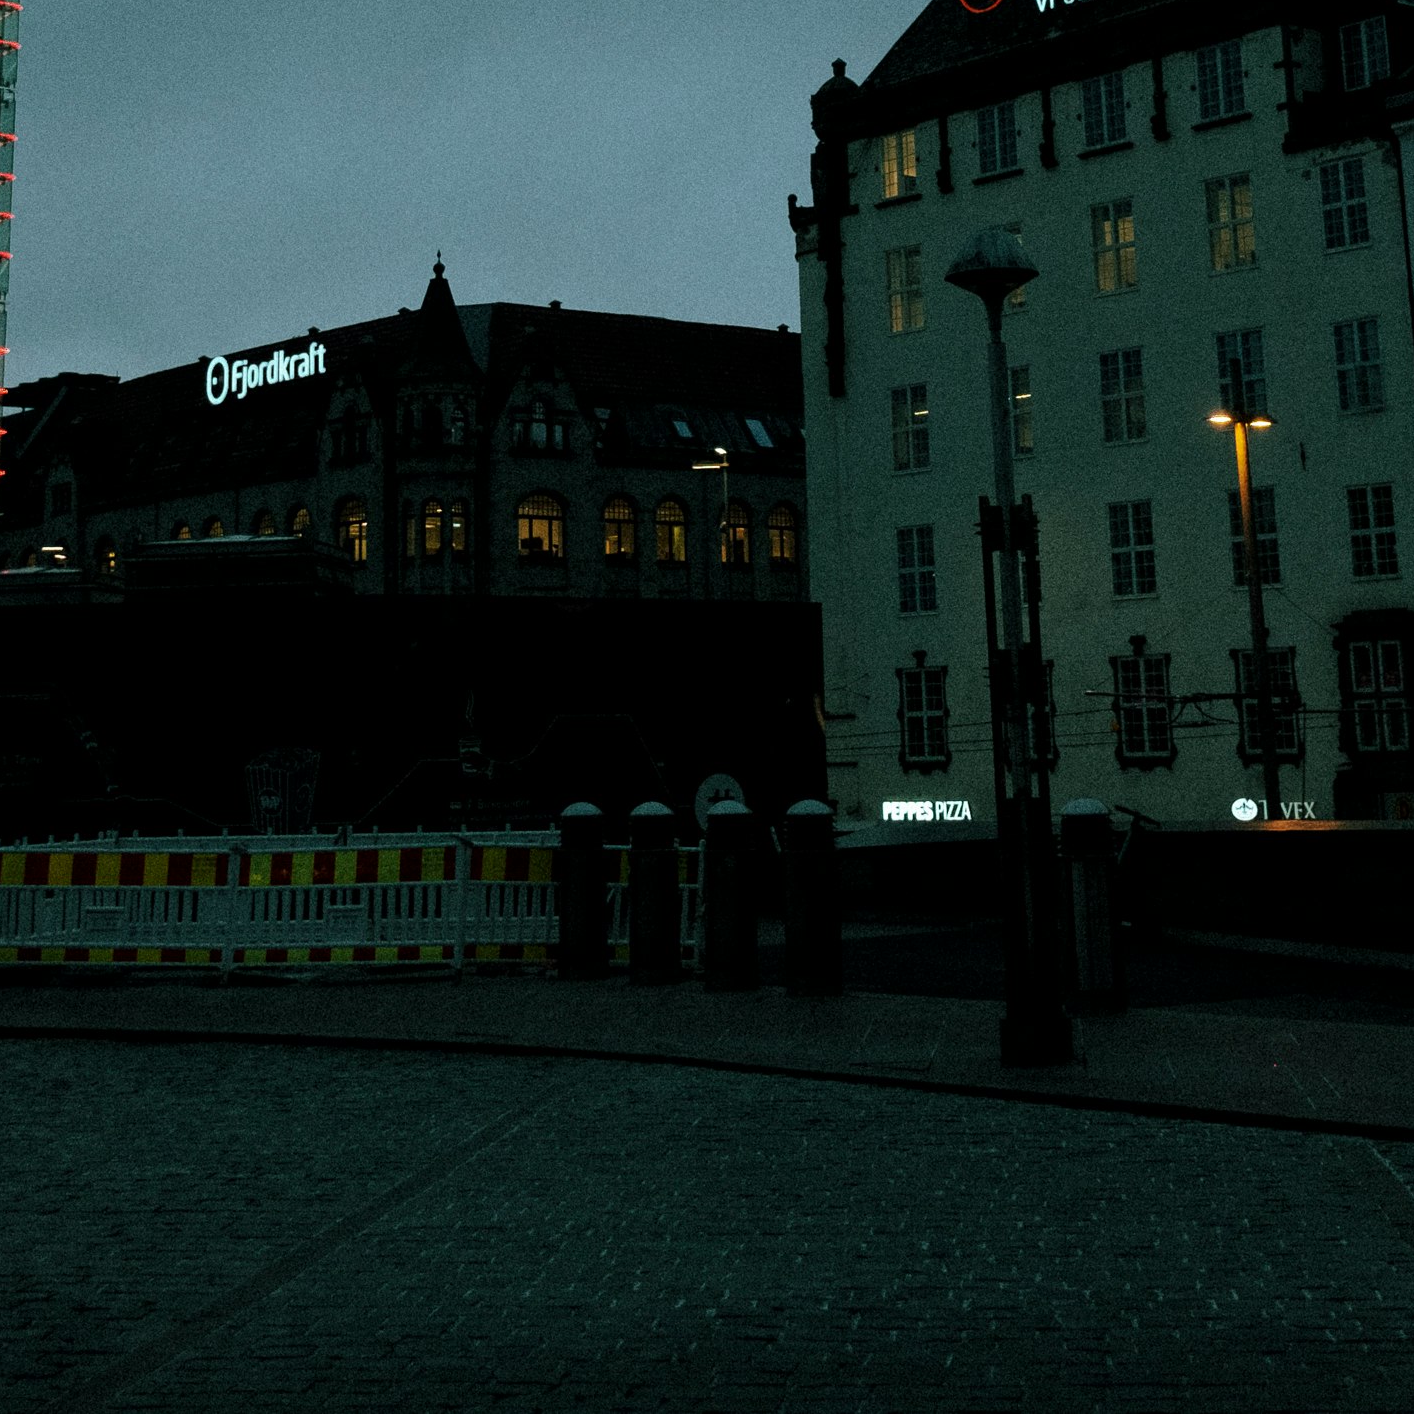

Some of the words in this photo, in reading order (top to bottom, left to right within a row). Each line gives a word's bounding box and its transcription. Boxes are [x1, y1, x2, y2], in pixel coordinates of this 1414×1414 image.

[231, 342, 327, 399] Fjordkraft
[882, 800, 934, 821] PEPPES
[934, 800, 972, 821] PIZZA
[1258, 799, 1316, 820] TVEX
